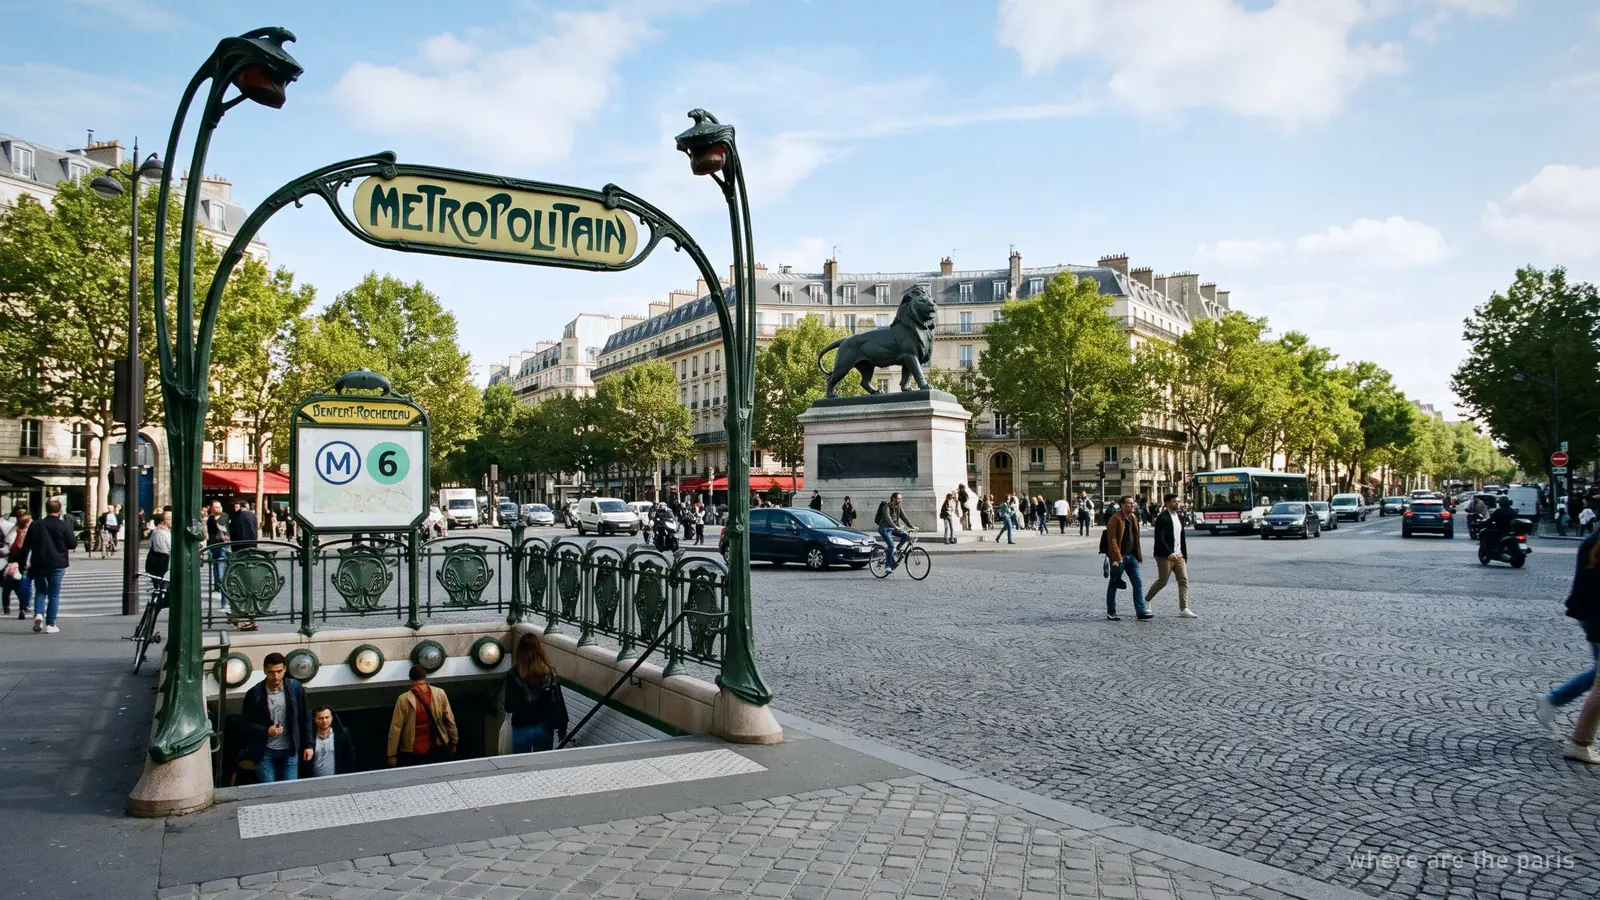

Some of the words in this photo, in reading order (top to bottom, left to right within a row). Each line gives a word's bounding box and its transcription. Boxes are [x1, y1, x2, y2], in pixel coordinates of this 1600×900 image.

[370, 183, 627, 257] METROPOLITAIN
[325, 451, 351, 475] M
[378, 450, 398, 477] 6
